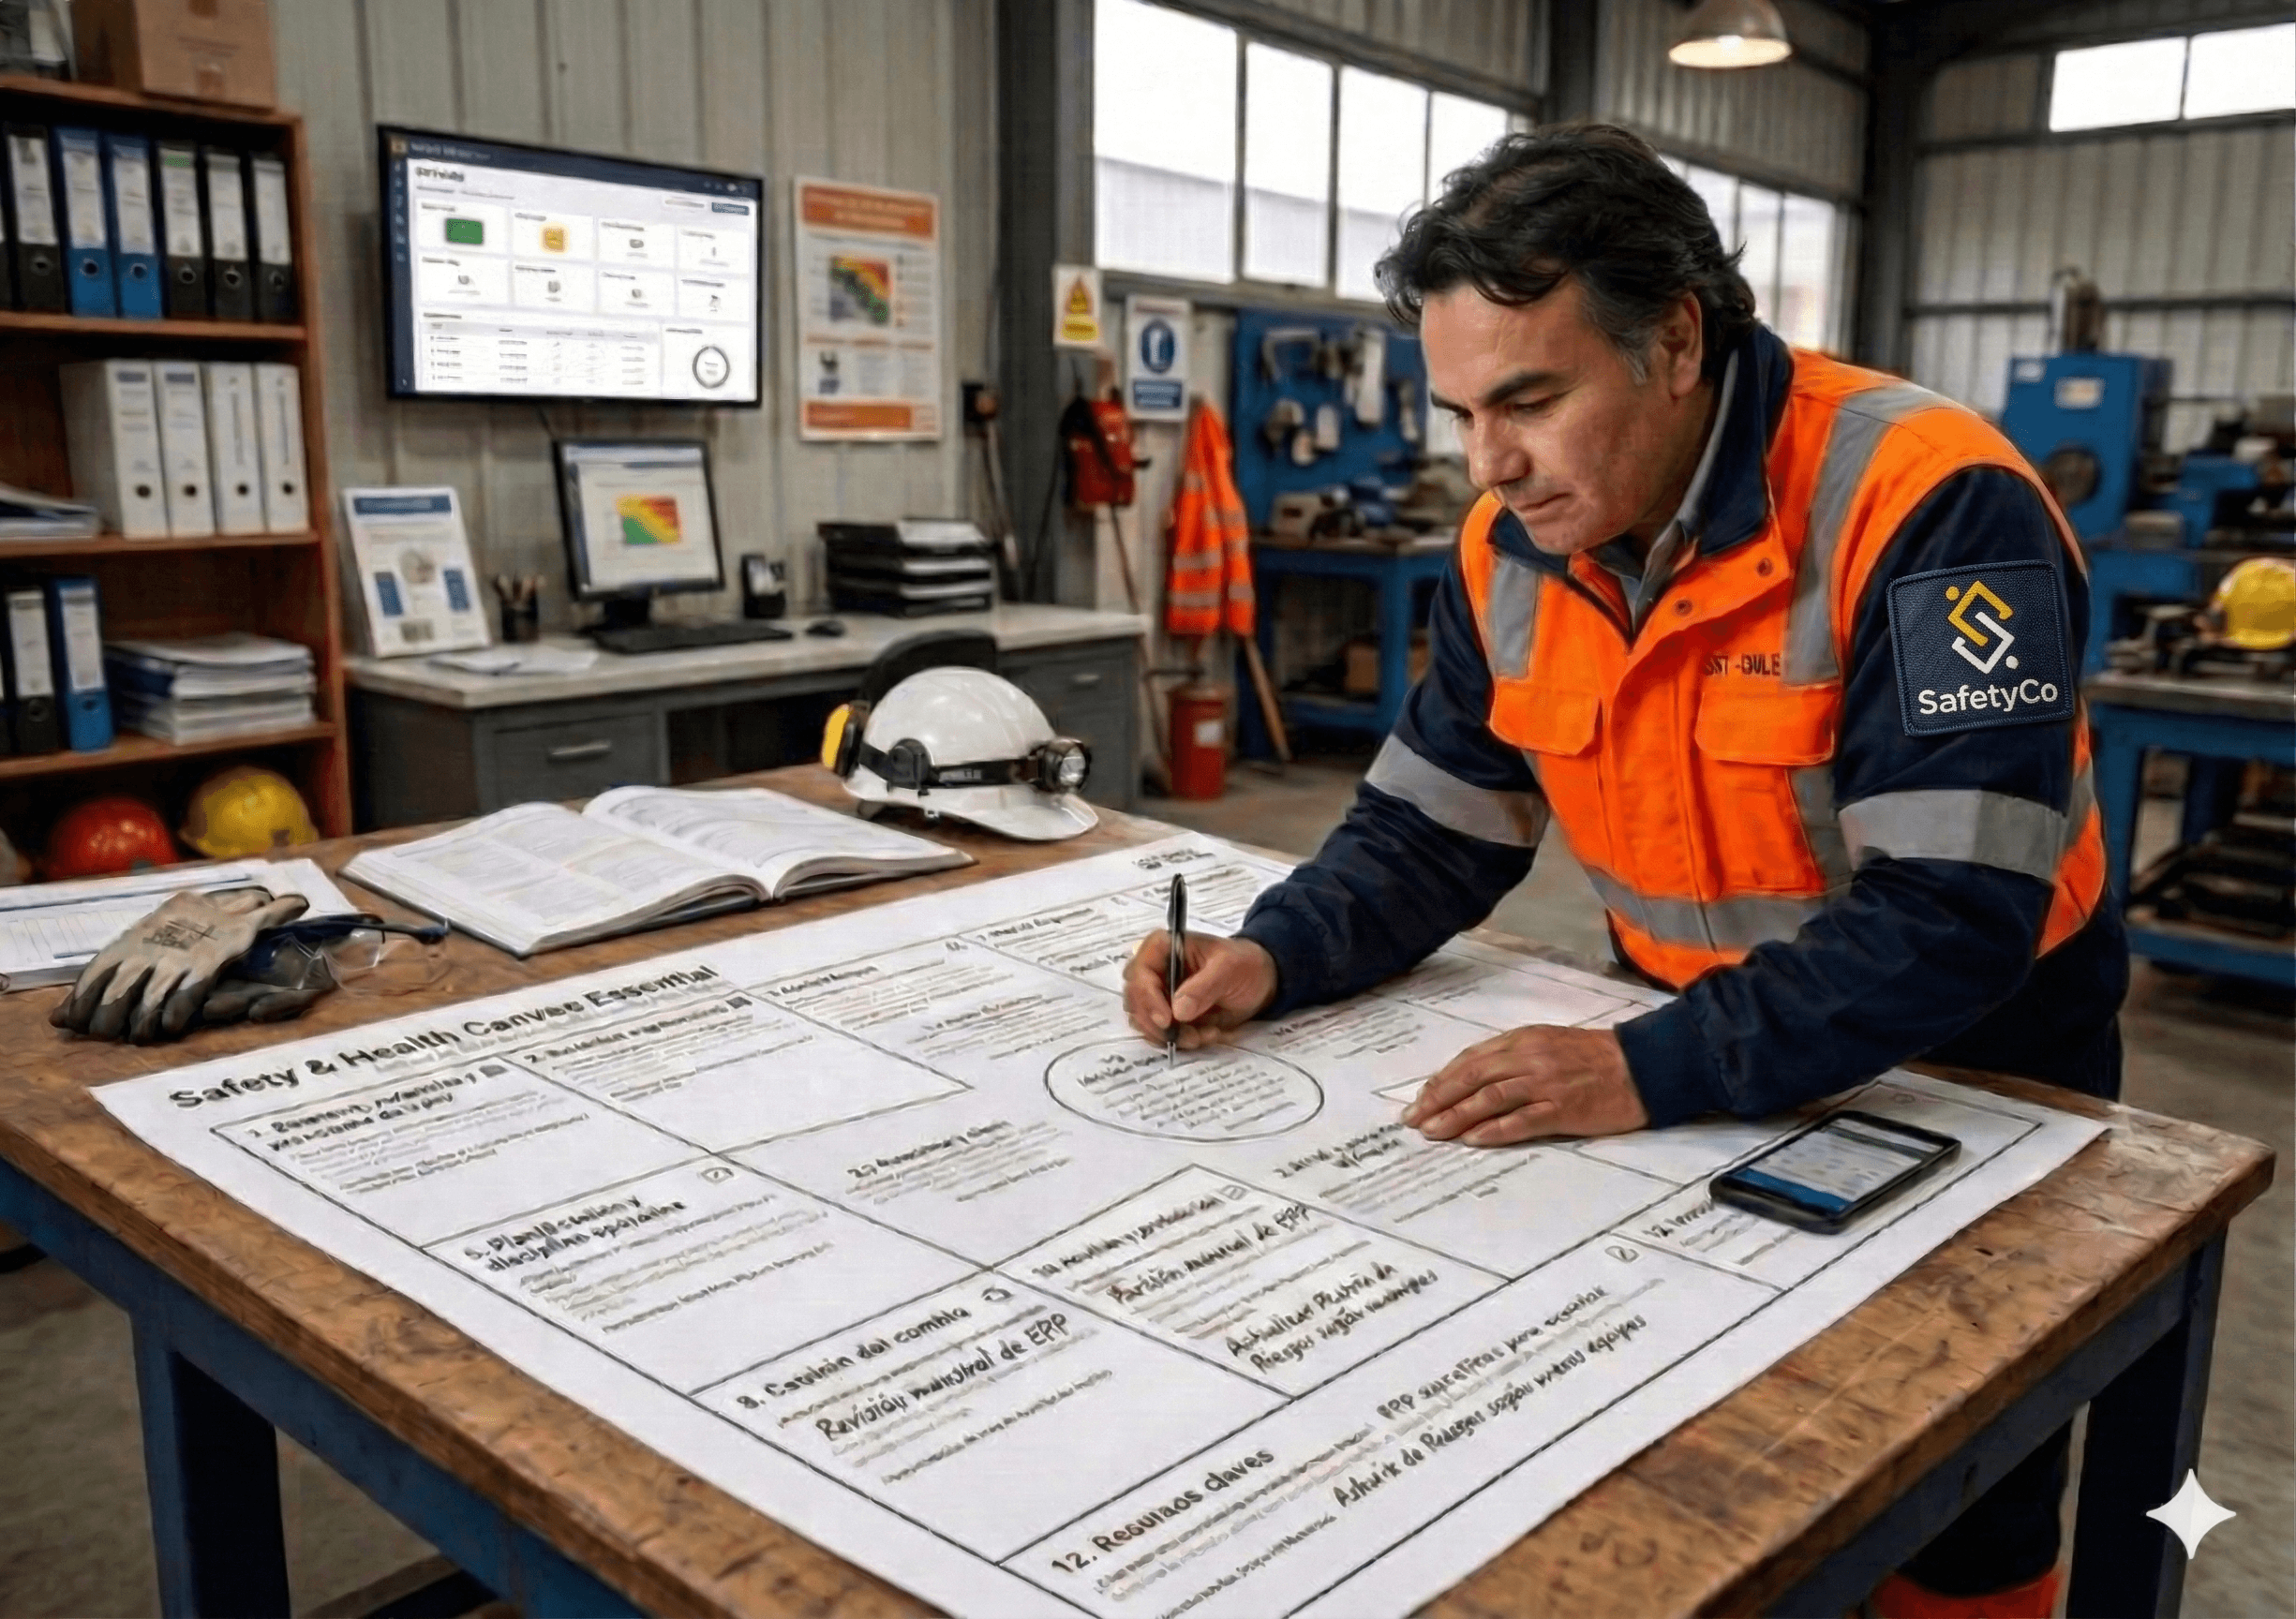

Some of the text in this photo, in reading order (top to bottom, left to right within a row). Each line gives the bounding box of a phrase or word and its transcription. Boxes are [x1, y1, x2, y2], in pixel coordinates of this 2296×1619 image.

[1917, 678, 2059, 715] SafetyCo
[169, 1068, 299, 1108] Safety
[305, 1059, 337, 1075] &
[337, 1031, 461, 1066] Health
[1000, 1340, 1028, 1361] de
[1051, 1551, 1098, 1574] 12.
